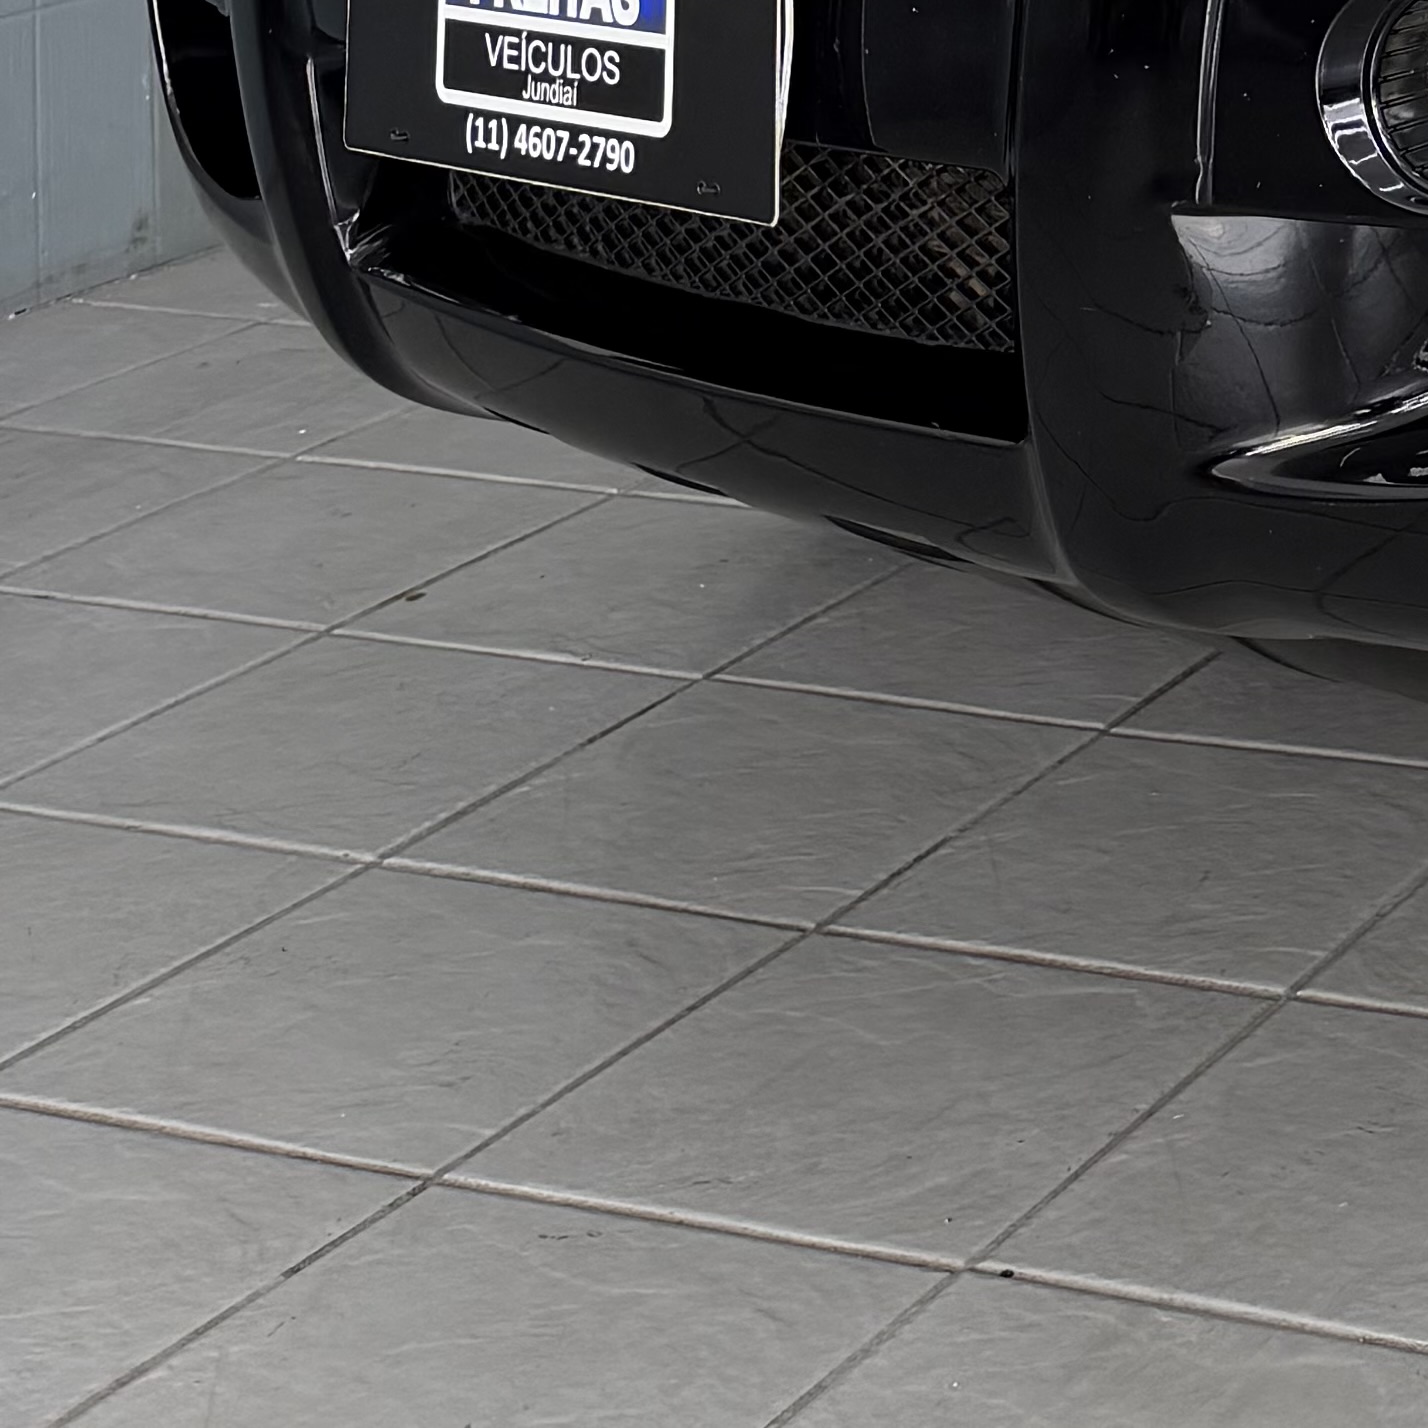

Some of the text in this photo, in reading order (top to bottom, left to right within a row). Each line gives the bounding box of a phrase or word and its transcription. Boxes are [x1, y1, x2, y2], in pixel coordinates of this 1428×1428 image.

[484, 30, 620, 85] VEÍCULOS
[521, 73, 579, 107] Jundiaí
[465, 112, 635, 174] (11) 4607-2790
